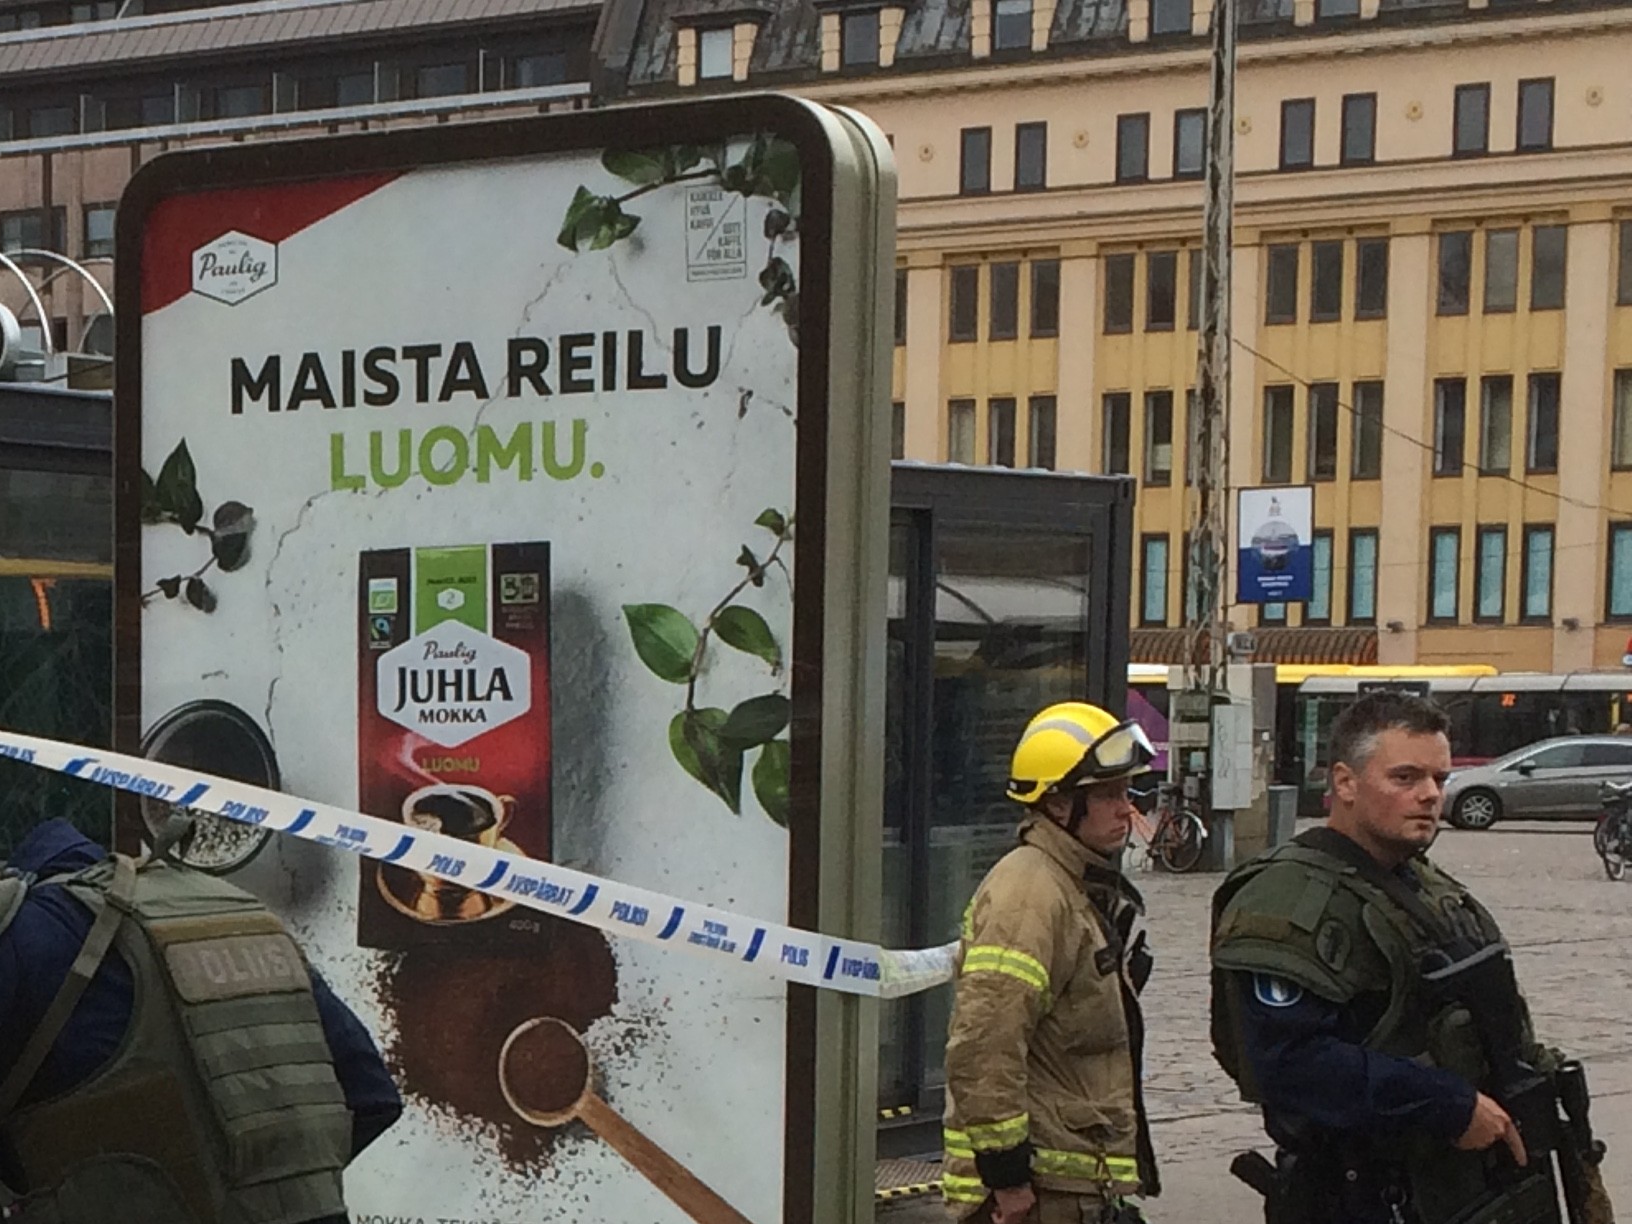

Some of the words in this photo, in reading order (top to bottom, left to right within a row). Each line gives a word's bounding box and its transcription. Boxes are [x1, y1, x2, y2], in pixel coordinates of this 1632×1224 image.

[198, 250, 268, 283] Paulig
[231, 341, 489, 414] MAISTA
[507, 325, 722, 398] REILU
[330, 418, 605, 490] LUOMU.
[423, 640, 477, 665] Paulig
[394, 666, 514, 713] JUHLA
[419, 708, 487, 724] MOKKA
[422, 757, 480, 772] LUOMU
[425, 854, 467, 878] POLIS
[503, 873, 575, 907] AVSPÄRRAT
[780, 944, 810, 968] POLIS
